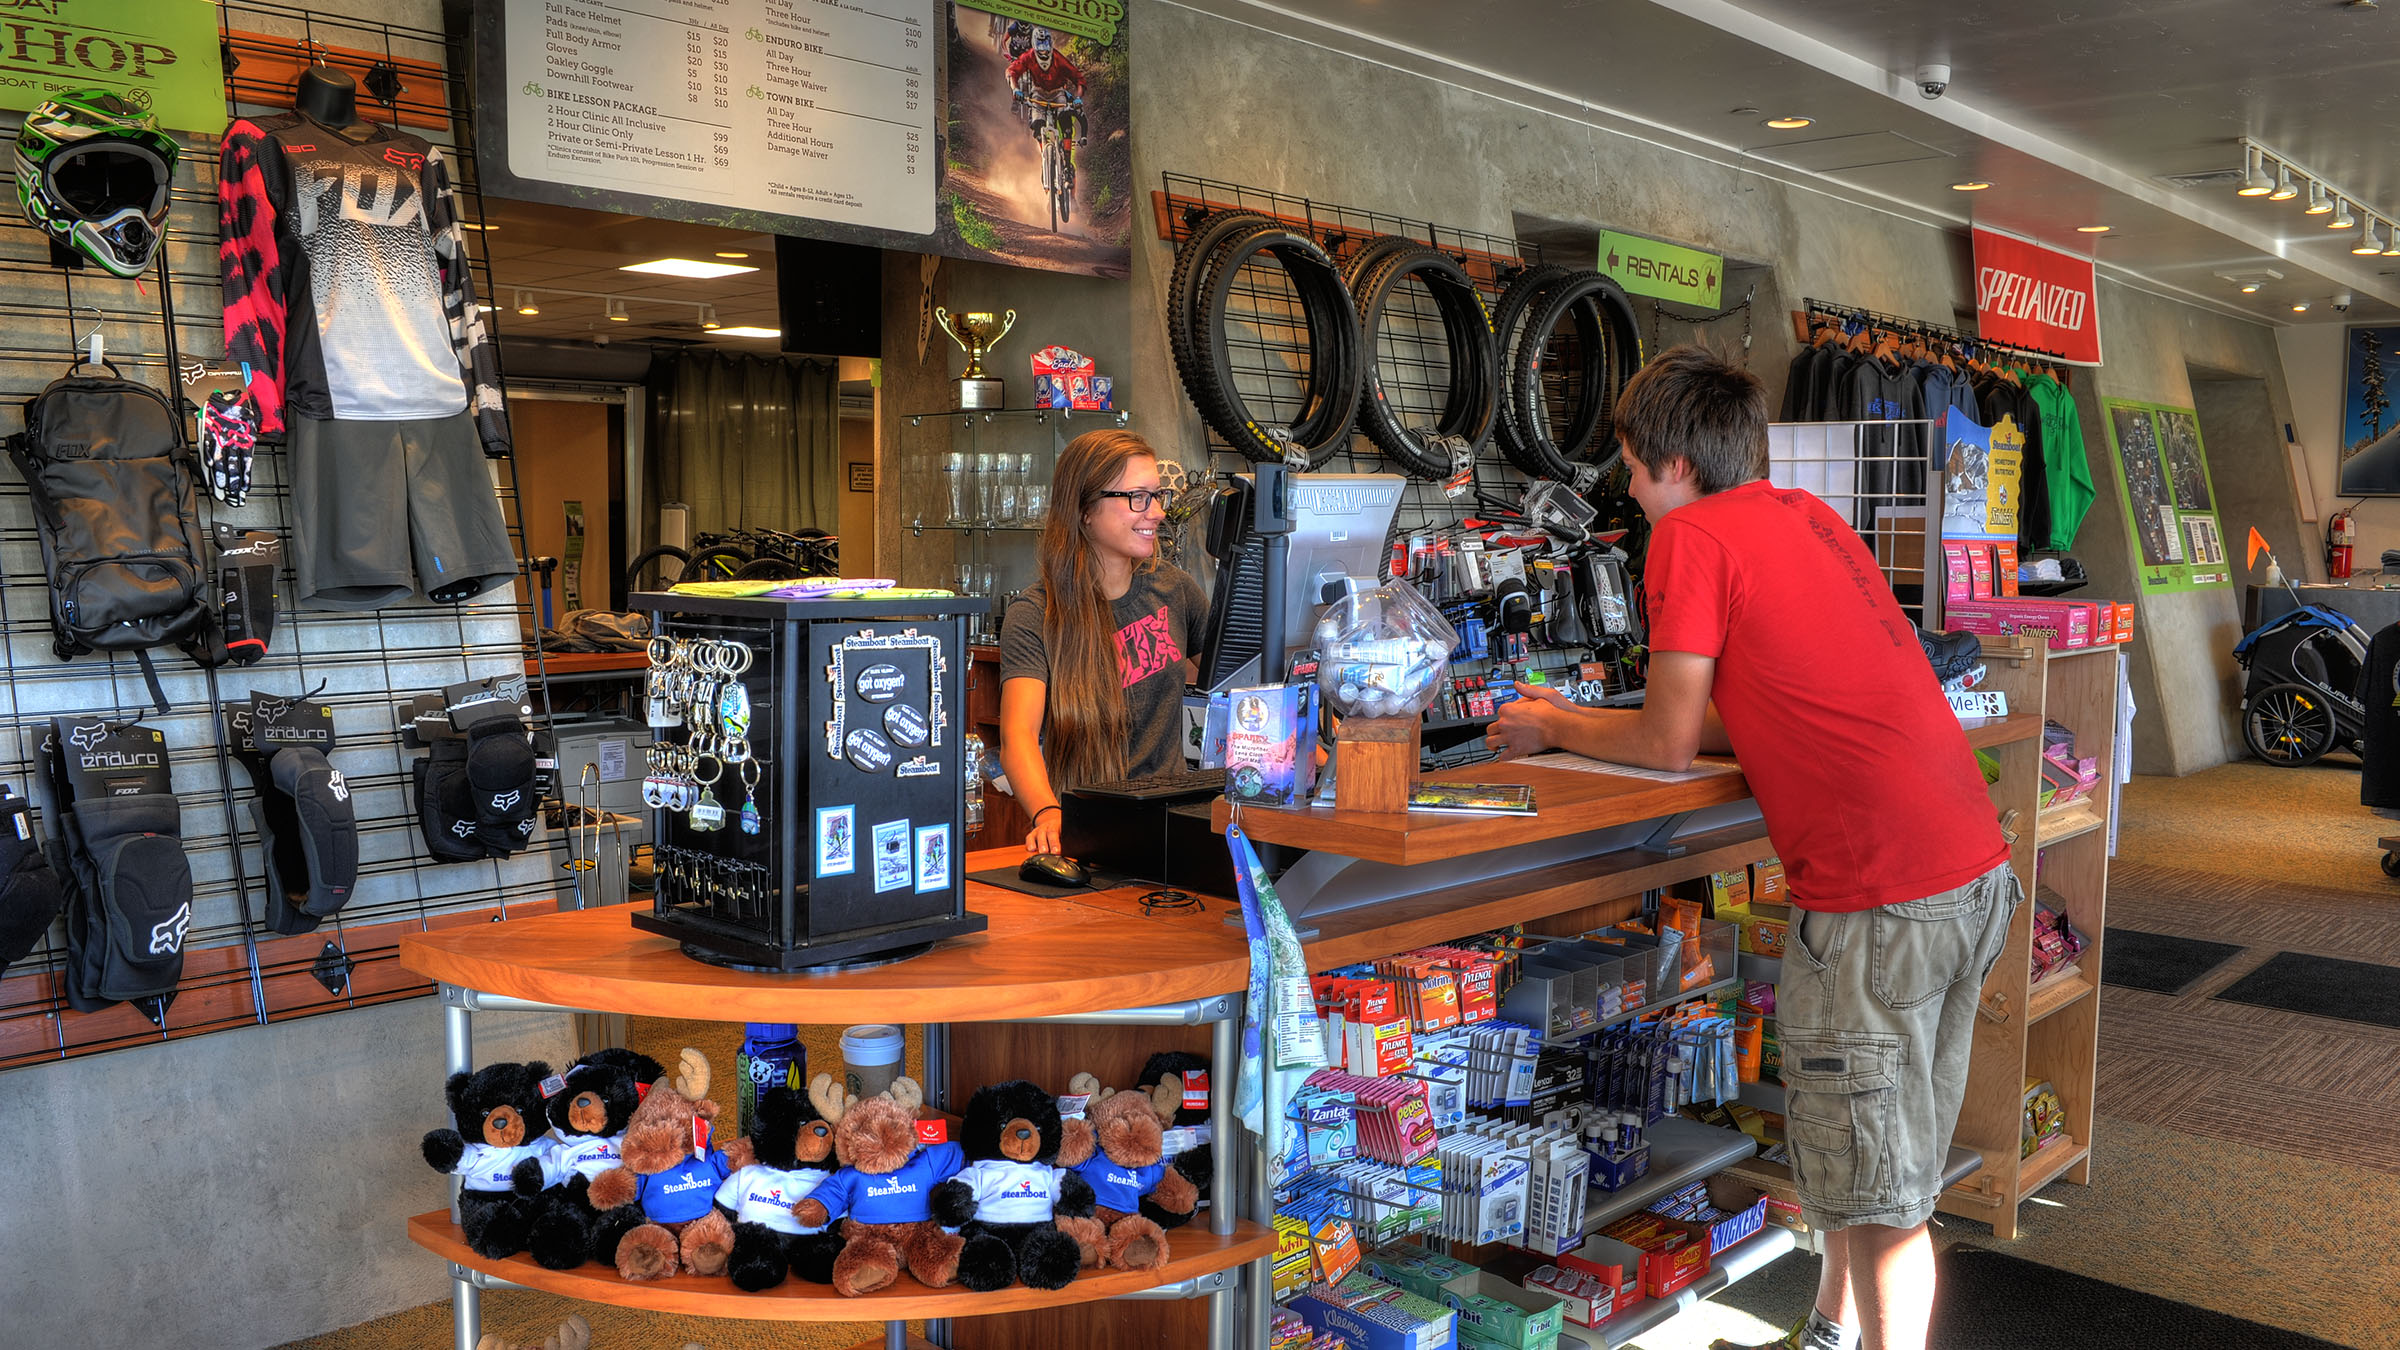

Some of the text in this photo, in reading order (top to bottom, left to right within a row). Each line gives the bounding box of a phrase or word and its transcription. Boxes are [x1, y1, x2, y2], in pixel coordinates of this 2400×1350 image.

[545, 2, 622, 26] Full Face Helmet
[545, 15, 568, 28] Pads
[765, 7, 811, 25] Three Hour
[545, 29, 622, 51] Full Body Armor
[687, 31, 701, 42] $15
[905, 27, 922, 39] $100
[545, 42, 578, 56] Gloves
[687, 43, 702, 55] $10
[713, 36, 728, 48] $20
[765, 34, 824, 54] ENDURO BIKE
[905, 39, 918, 49] $70
[0, 22, 177, 80] HOP
[713, 49, 727, 60] $15
[766, 49, 794, 63] All Day
[545, 55, 614, 76] Oakley Goggle
[687, 56, 702, 67] $20
[713, 61, 728, 72] $30
[766, 61, 812, 77] Three Hour
[546, 68, 634, 92] Downhill Footwear
[687, 68, 698, 79] $5
[713, 74, 728, 84] $10
[687, 82, 702, 92] $10
[766, 73, 828, 93] Damage Waiver
[905, 78, 919, 88] $80
[687, 93, 698, 103] $8
[713, 86, 728, 97] $15
[906, 89, 919, 99] $50
[546, 89, 658, 116] BIKE LESSON PACKAGE
[713, 98, 728, 109] $10
[766, 92, 814, 109] TOWN BIKE
[906, 101, 918, 111] $17
[547, 104, 667, 133] 2 Hour Clinic All Inclusive
[767, 106, 795, 120] All Day
[547, 118, 634, 141] 2 Hour Clinic Only
[767, 118, 812, 134] Three Hour
[713, 132, 728, 143] $99
[767, 130, 834, 150] Additional Hours
[906, 132, 919, 142] $25
[548, 131, 707, 164] Private or Semi-Private Lesson Hr.
[713, 145, 728, 155] $69
[767, 142, 828, 160] Damage Waiver
[906, 143, 919, 153] $20
[548, 151, 570, 160] Enduro
[713, 157, 729, 167] $69
[906, 155, 916, 163] $5
[906, 166, 916, 175] $3
[1627, 256, 1699, 288] RENTALS
[1978, 266, 2086, 331] SPECIALIZED
[56, 443, 93, 458] FOX
[2019, 625, 2059, 641] STINGER
[846, 636, 886, 647] Steamboat
[890, 636, 929, 646] Steamboat
[932, 639, 941, 689] Steamboat
[833, 648, 843, 699] Steamboat
[859, 674, 905, 692] got oxygen?
[1948, 694, 1980, 711] Me!
[885, 708, 928, 740] got oxygen?
[934, 694, 942, 743] Steamboat
[265, 726, 328, 739] enduro
[832, 705, 843, 756] Steamboat
[846, 733, 892, 766] got oxygen?
[81, 752, 159, 768] enduro
[899, 763, 938, 774] Steamboat
[115, 787, 141, 796] FOX
[1464, 970, 1492, 985] TYLENOL
[1381, 1039, 1408, 1055] TYLENOL
[1534, 1074, 1553, 1088] Lexar
[1312, 1105, 1351, 1121] Zantac
[1340, 1115, 1350, 1124] 75
[1398, 1100, 1424, 1125] Pepto
[577, 1149, 621, 1163] Steamboa
[664, 1176, 713, 1195] Steamboat
[867, 1180, 918, 1198] Steamboat
[1001, 1184, 1048, 1200] Steamboat
[1711, 1199, 1766, 1256] SNICKERS
[1277, 1236, 1303, 1258] Advil
[1322, 1309, 1366, 1342] Kleenex
[1528, 1319, 1552, 1336] Orbit
